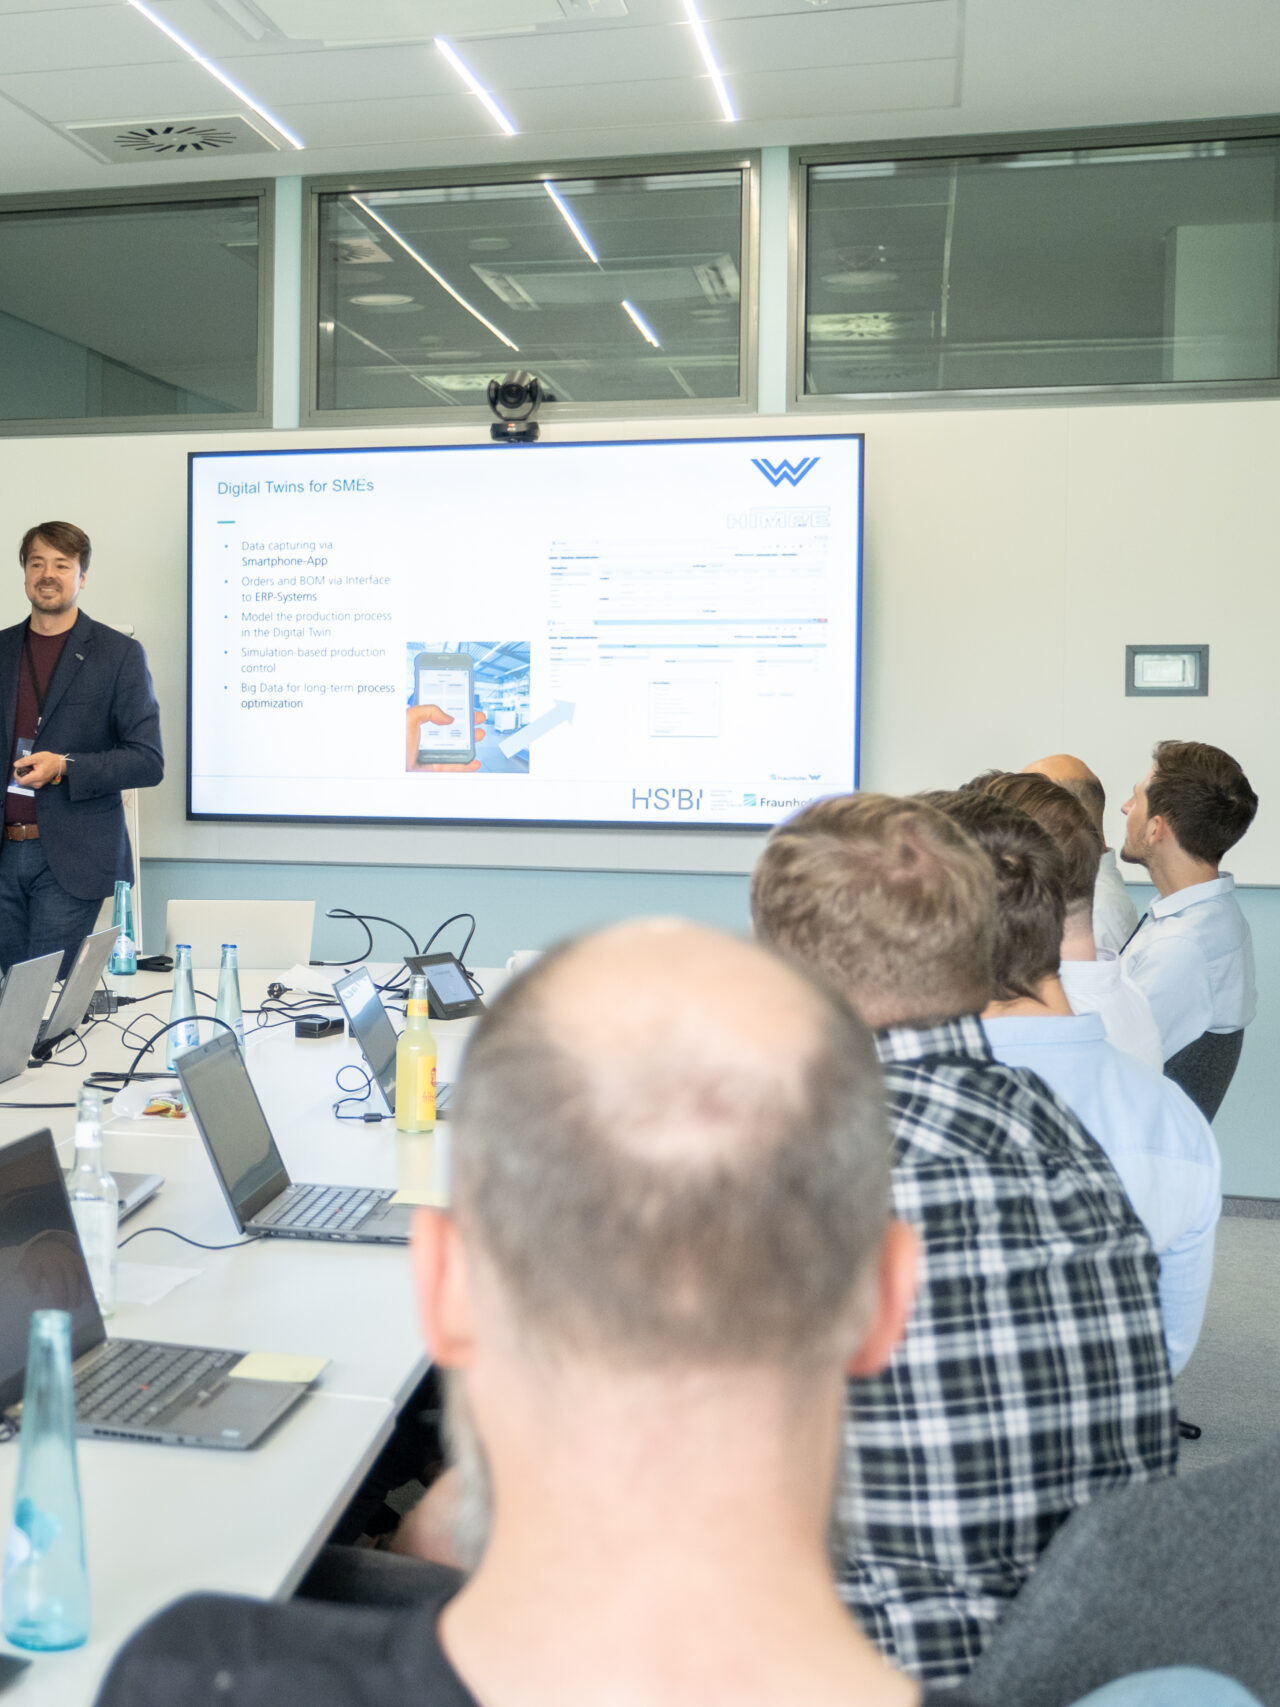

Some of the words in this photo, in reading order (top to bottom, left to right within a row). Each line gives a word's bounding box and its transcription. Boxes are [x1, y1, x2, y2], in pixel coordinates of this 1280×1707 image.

[217, 480, 261, 498] Digital
[265, 480, 305, 494] Twins
[309, 479, 328, 493] for
[331, 478, 375, 493] SMEs
[241, 541, 266, 552] Data
[267, 540, 316, 552] capturing
[319, 540, 334, 550] via
[241, 555, 329, 568] Smartphone-App
[241, 575, 274, 587] Orders
[277, 575, 297, 586] and
[328, 574, 343, 586] via
[241, 593, 252, 602] to
[255, 591, 318, 603] ERP-Systems
[241, 611, 273, 622] Model
[276, 611, 293, 622] the
[295, 611, 351, 623] production
[354, 612, 393, 622] process
[241, 627, 251, 637] in
[253, 627, 270, 637] the
[273, 627, 305, 640] Digital
[308, 627, 332, 637] Twin
[241, 646, 328, 658] Simulation-based
[330, 647, 387, 659] production
[241, 662, 277, 674] control
[241, 683, 257, 695] Big
[260, 683, 284, 693] Data
[286, 682, 301, 693] for
[304, 683, 354, 695] long-term
[357, 684, 396, 695] process
[241, 698, 304, 711] optimization
